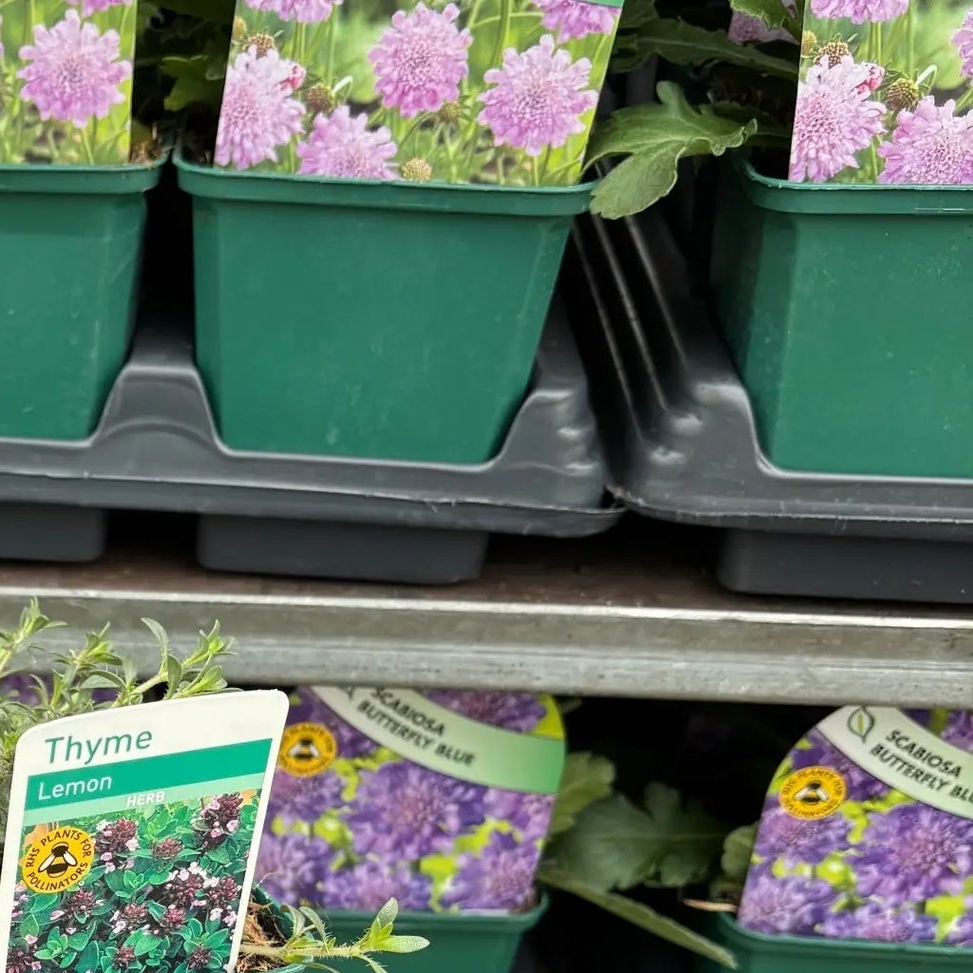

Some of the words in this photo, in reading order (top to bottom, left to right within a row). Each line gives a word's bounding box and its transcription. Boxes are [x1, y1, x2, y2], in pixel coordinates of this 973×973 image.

[370, 686, 445, 738] SCABIOSA
[45, 730, 152, 765] Thyme
[358, 700, 435, 749] BUTTERFLY
[434, 741, 475, 768] BLUE
[870, 743, 951, 792] BUTTERFLY
[886, 730, 962, 779] SCABIOSA
[38, 776, 112, 801] Lemon
[126, 790, 166, 808] HERB
[40, 829, 82, 847] PLANTS
[79, 838, 92, 858] FOR
[26, 847, 41, 868] RHS
[26, 861, 88, 891] POLLINATORS
